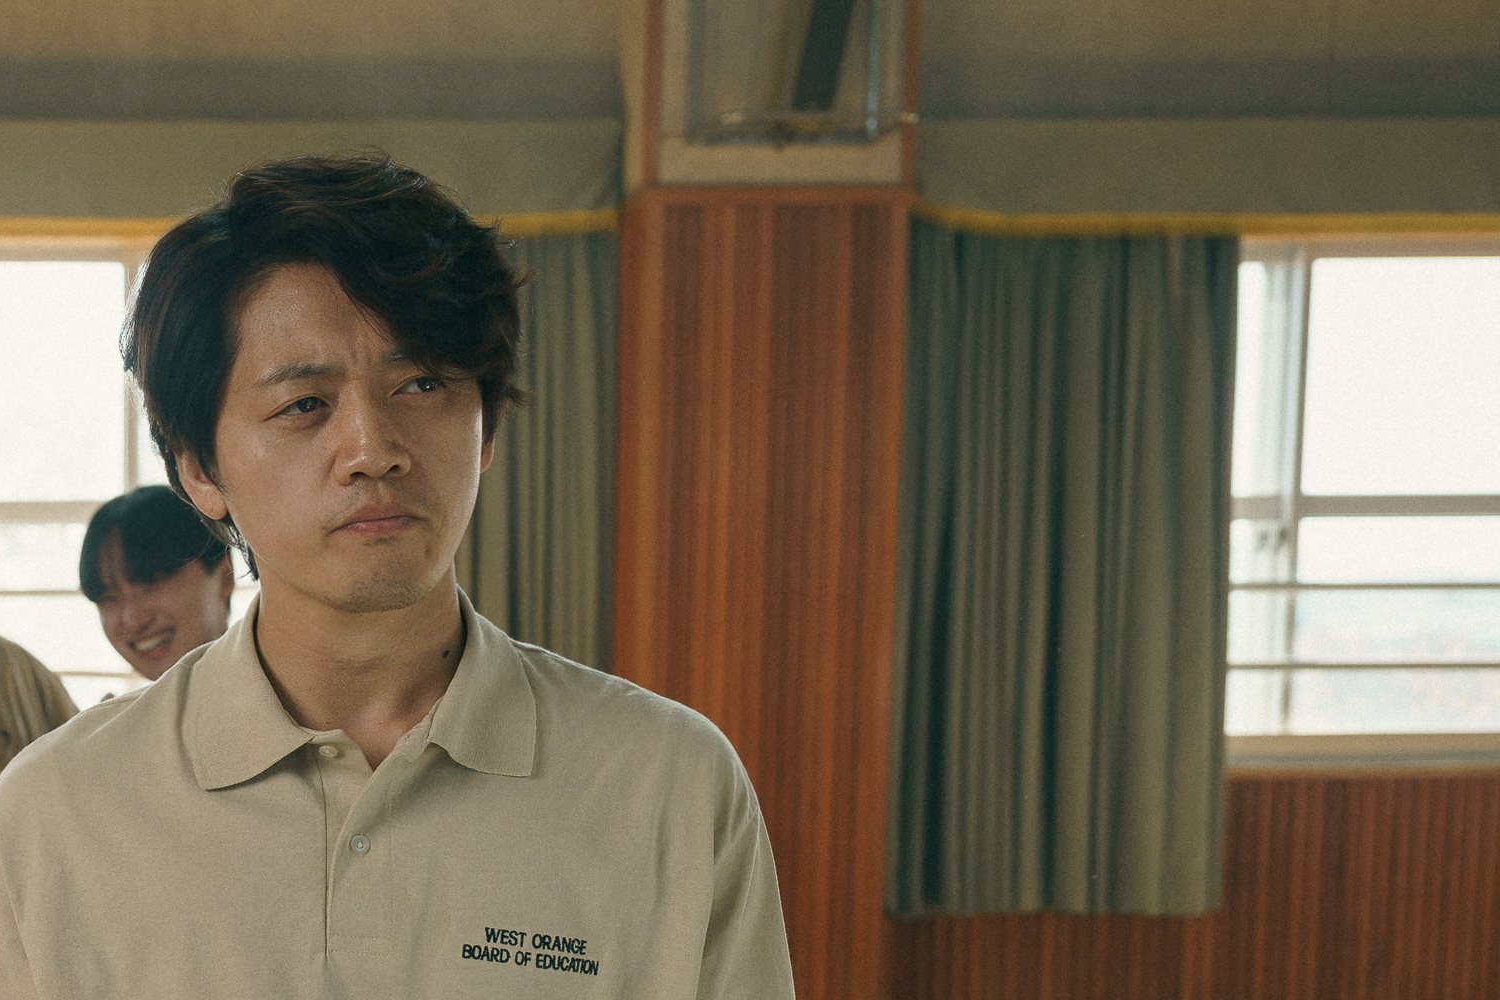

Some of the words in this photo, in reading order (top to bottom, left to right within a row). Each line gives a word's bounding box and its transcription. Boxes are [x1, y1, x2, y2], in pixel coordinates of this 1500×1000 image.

[485, 927, 527, 947] WEST
[531, 933, 587, 955] ORANGE
[462, 944, 511, 963] BOARD
[514, 950, 532, 966] OF
[535, 953, 599, 975] EDUCATION
